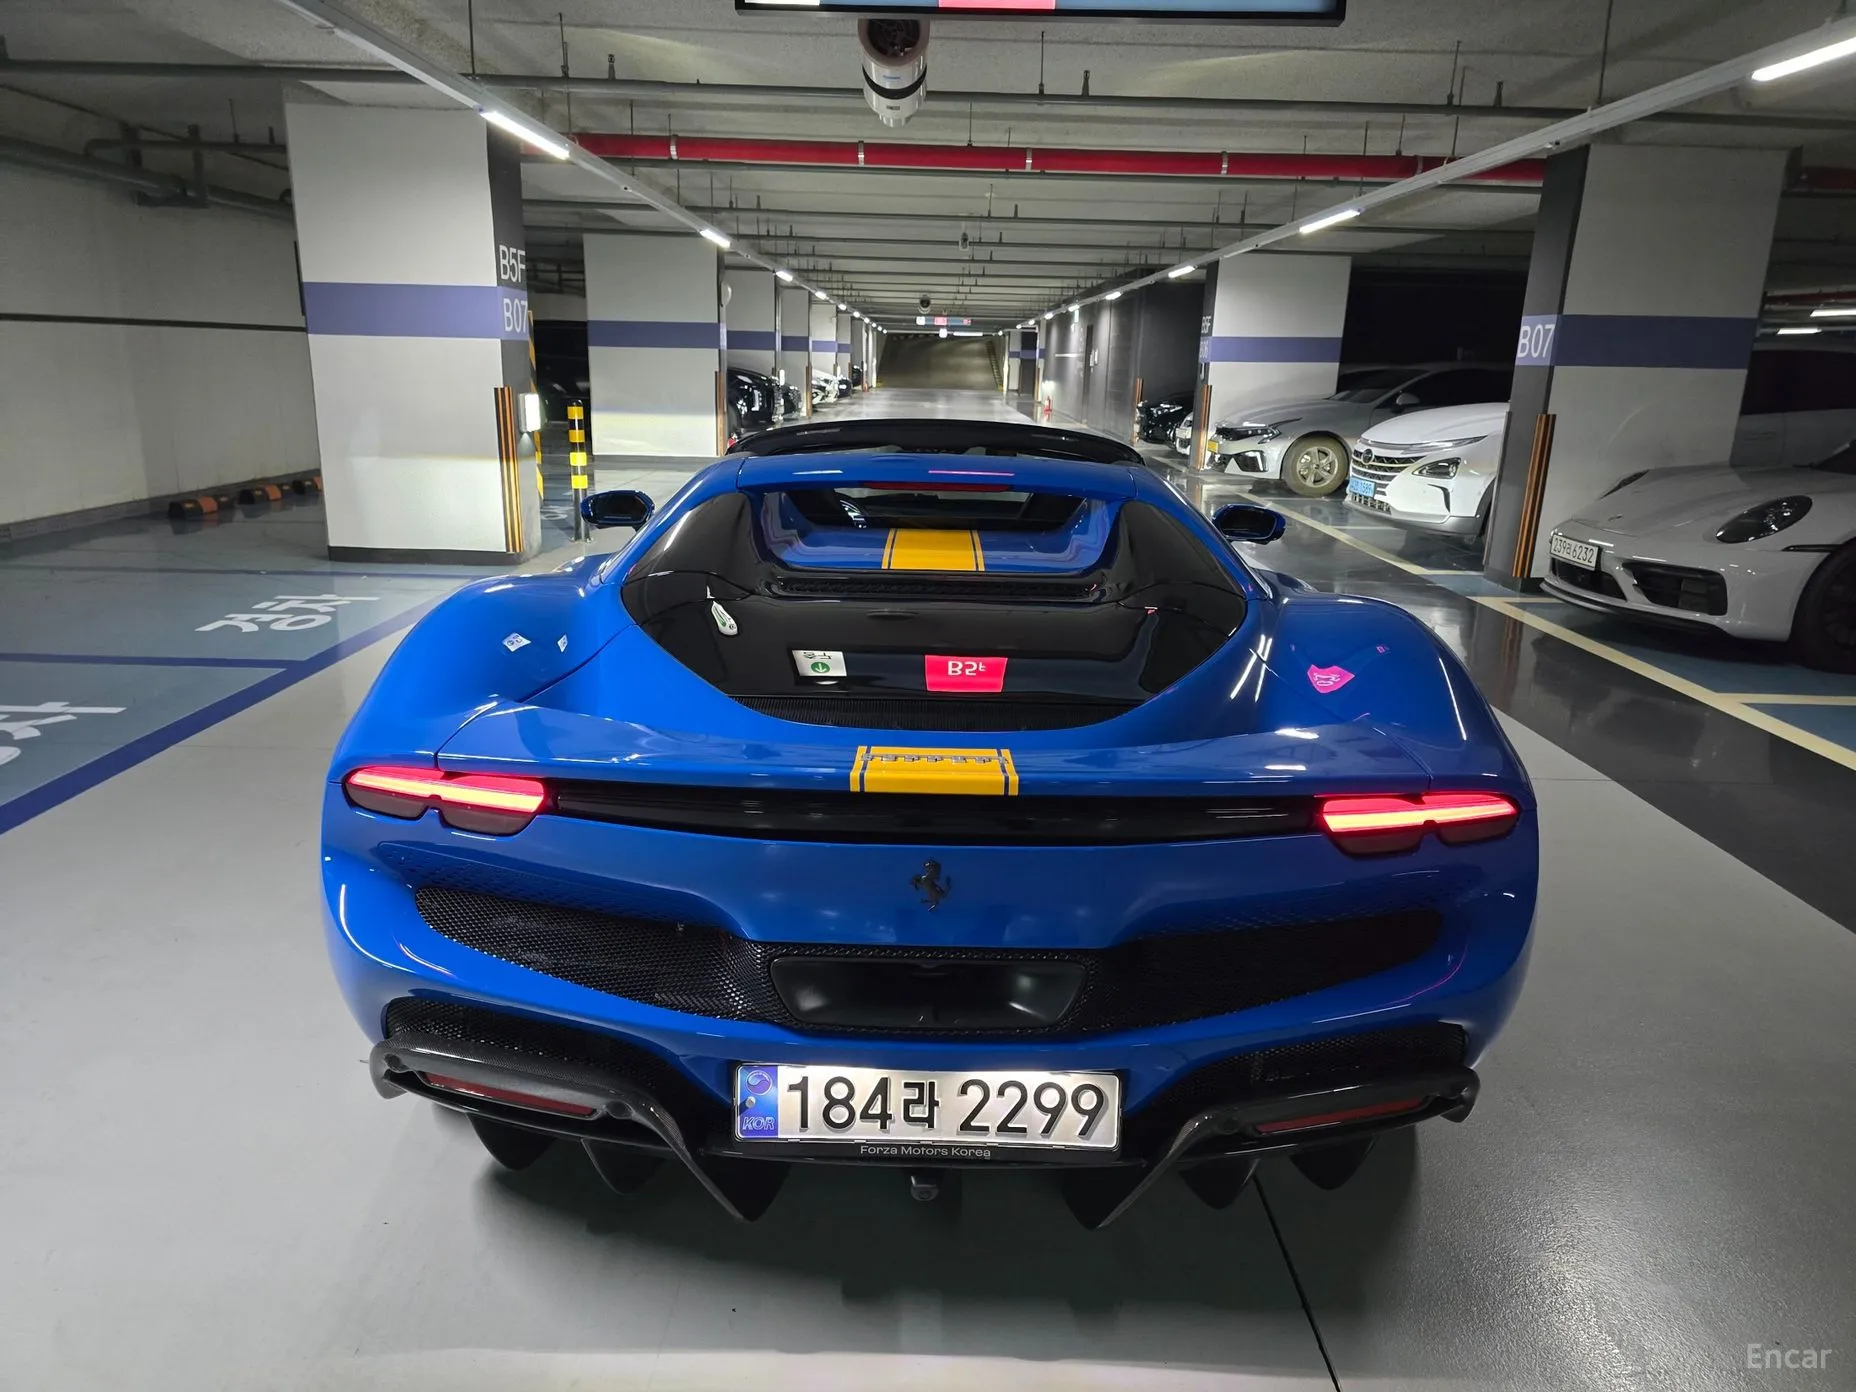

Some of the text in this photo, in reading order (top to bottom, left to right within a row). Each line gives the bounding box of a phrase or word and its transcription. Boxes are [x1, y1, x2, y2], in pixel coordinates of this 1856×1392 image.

[499, 244, 526, 283] B5F
[503, 298, 528, 333] B07
[1517, 324, 1556, 358] B07
[786, 1075, 1106, 1137] 184라 2299
[742, 1116, 776, 1131] KOR
[860, 1145, 991, 1157] Forza Motors Korea
